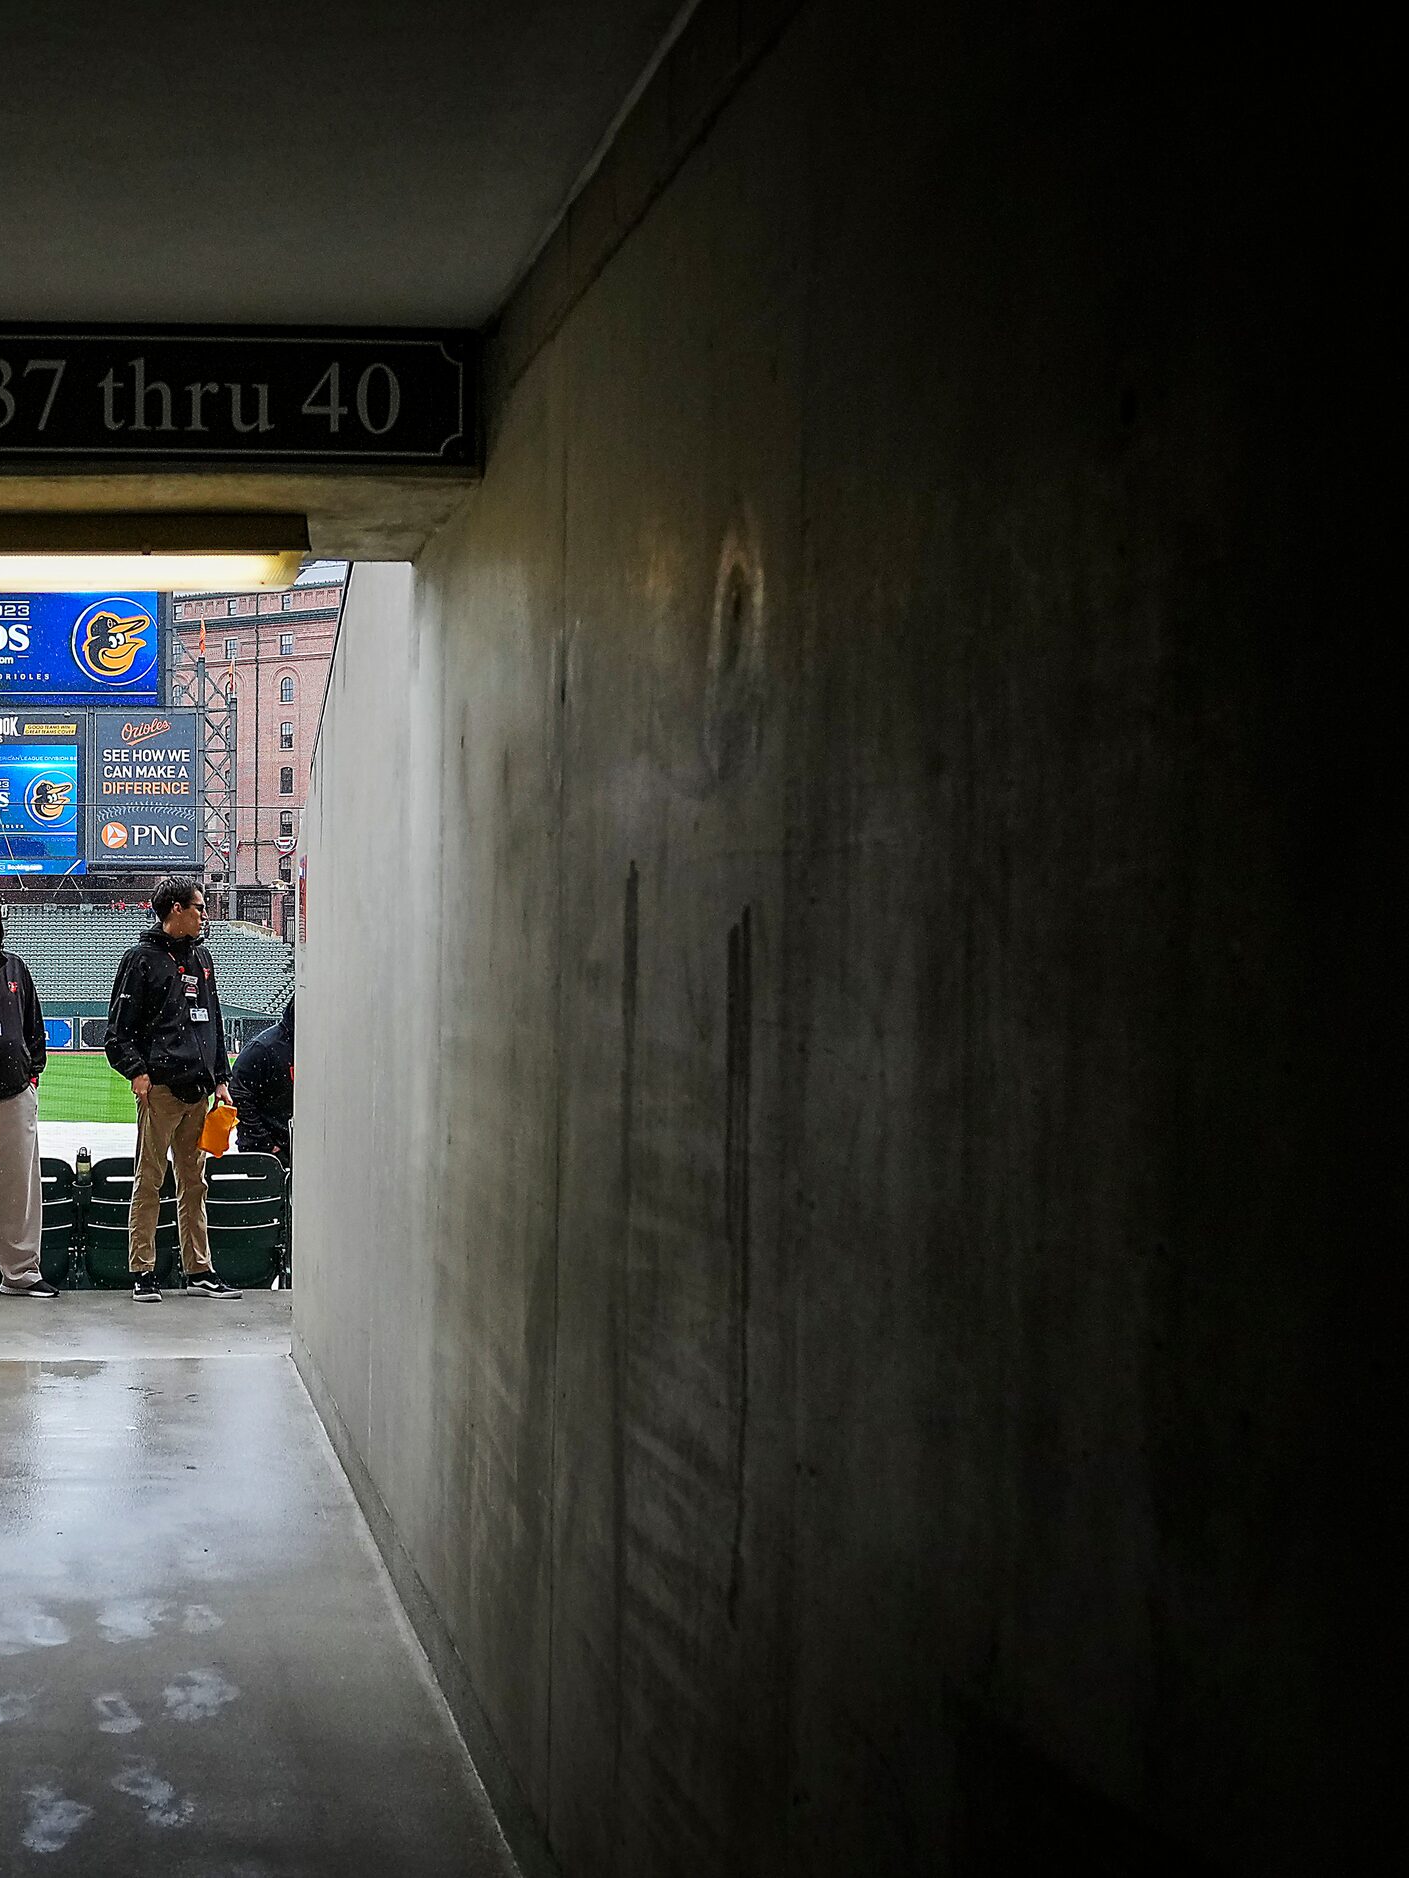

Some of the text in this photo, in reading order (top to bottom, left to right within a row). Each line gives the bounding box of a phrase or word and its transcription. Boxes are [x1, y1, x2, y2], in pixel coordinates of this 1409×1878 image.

[97, 356, 276, 433] thru
[300, 360, 401, 435] 40
[121, 718, 171, 742] Orioles
[103, 749, 191, 762] SEE HOW WE
[103, 765, 189, 778] CAN MAKE A
[102, 782, 190, 795] DIFFERENCE
[131, 824, 189, 846] PNC
